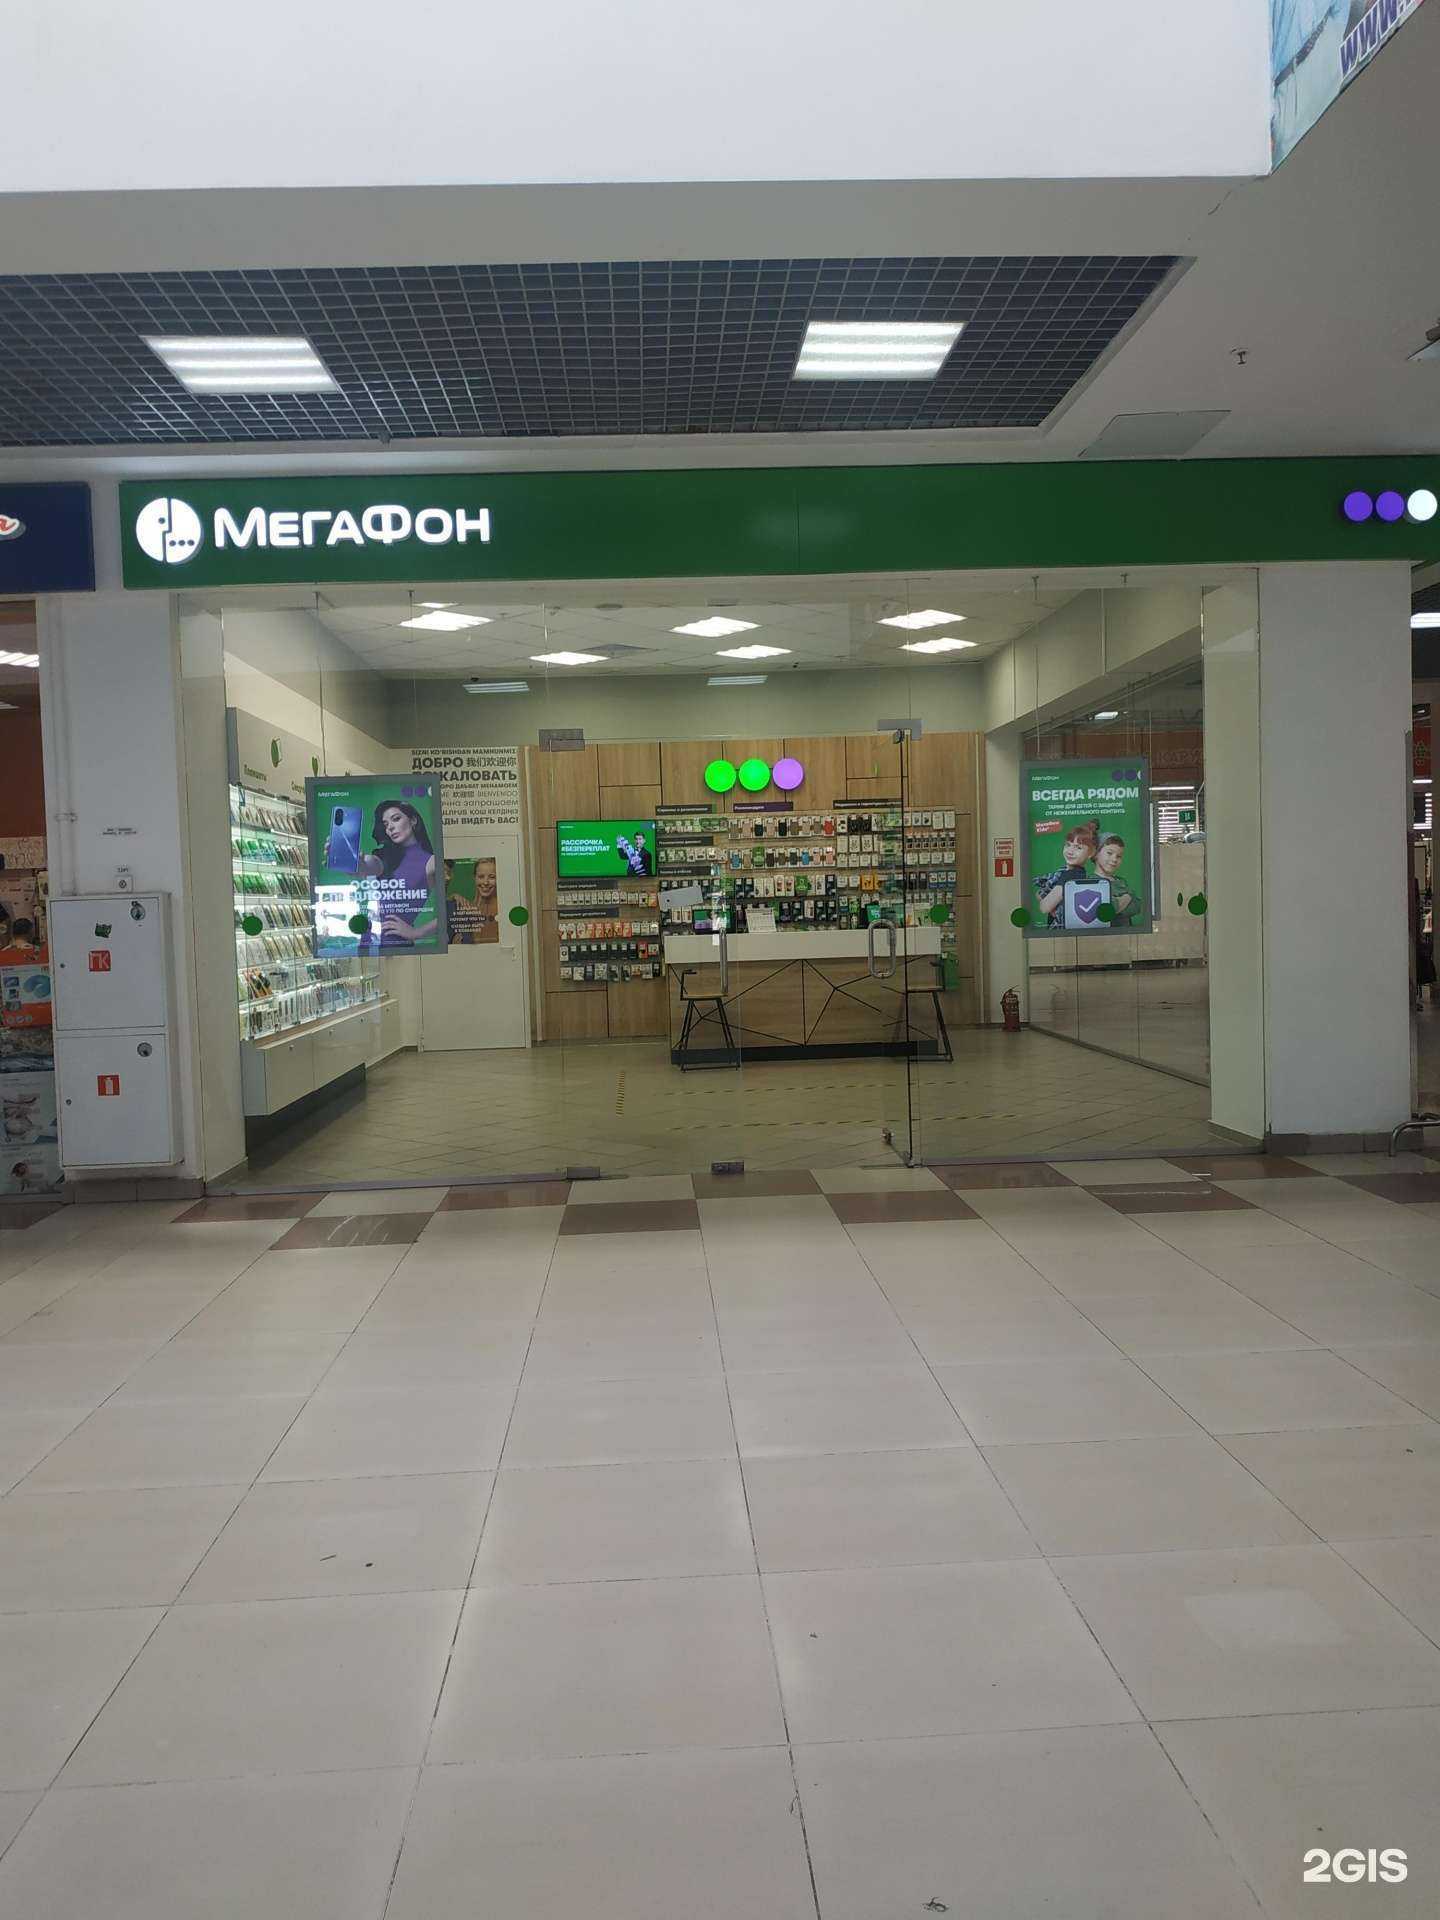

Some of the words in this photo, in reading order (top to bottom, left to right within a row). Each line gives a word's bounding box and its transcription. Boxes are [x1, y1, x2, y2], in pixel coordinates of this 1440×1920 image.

[412, 757, 463, 770] ДОБРО
[1032, 789, 1085, 802] ВСЕГДА
[1088, 787, 1139, 800] РЯДОМ
[461, 816, 495, 826] ВИДЕТЬ
[350, 879, 406, 890] ОСОБОЕ
